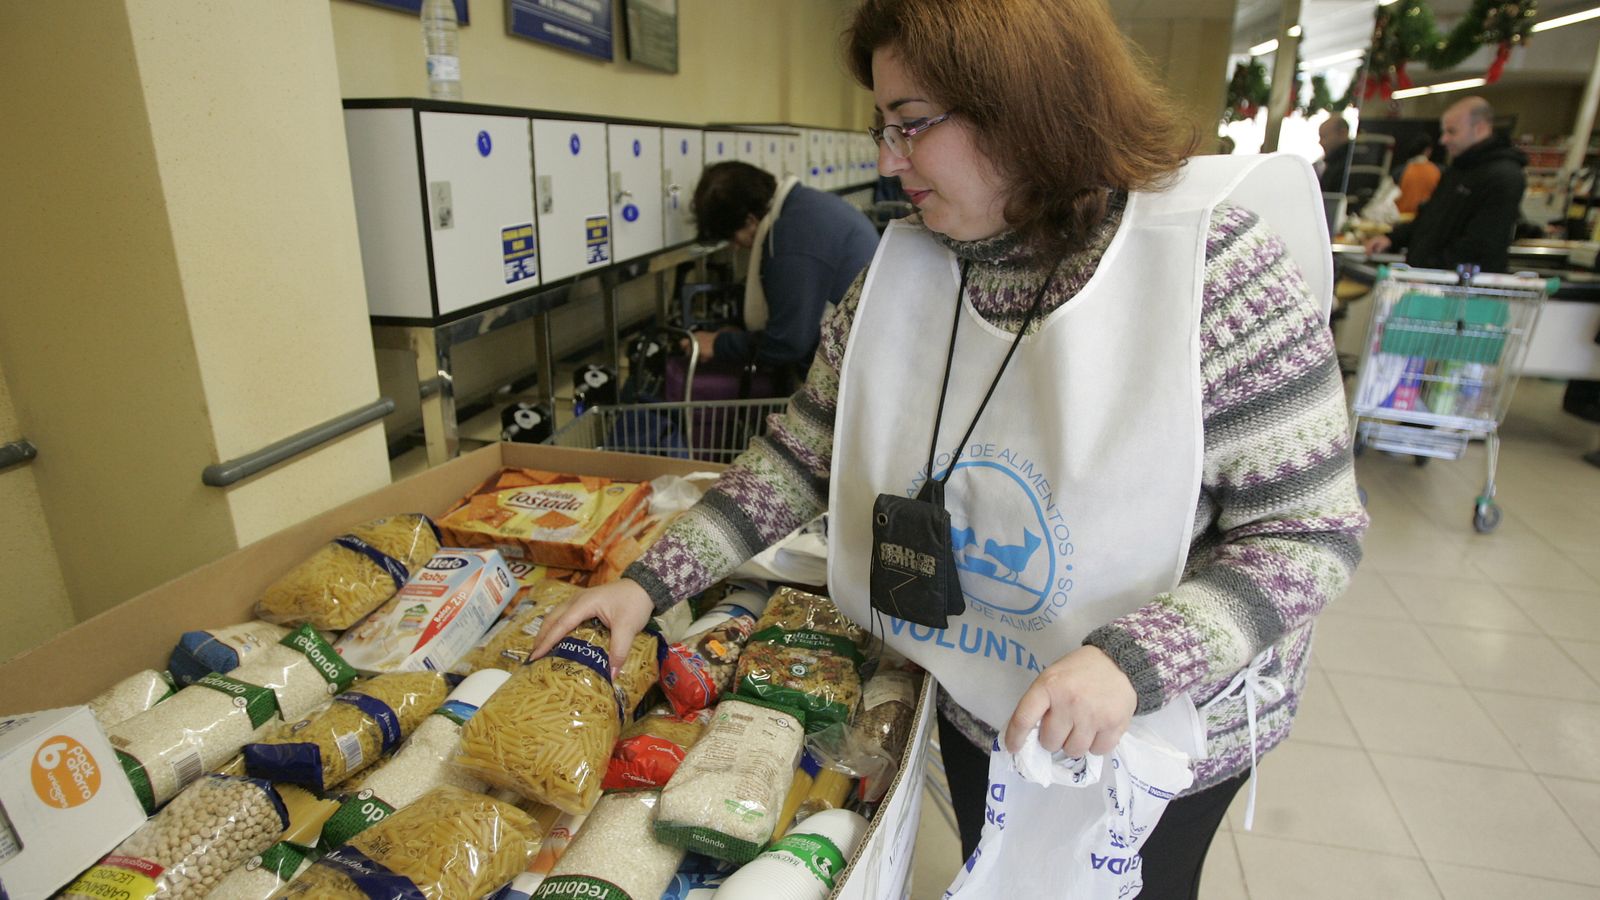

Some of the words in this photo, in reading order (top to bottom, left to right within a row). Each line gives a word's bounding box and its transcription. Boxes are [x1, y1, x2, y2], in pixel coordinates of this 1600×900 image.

[507, 491, 586, 513] Tostada
[906, 448, 964, 498] ANCOS
[969, 443, 996, 458] DE
[999, 447, 1075, 557] ALIMENTOS
[427, 557, 464, 570] Hero
[1000, 576, 1074, 633] ALIMENTOS
[293, 635, 340, 680] redondo
[559, 641, 609, 669] MACARR
[889, 616, 1048, 674] VOLUNTA
[38, 743, 68, 770] 6
[67, 746, 95, 778] pack
[66, 757, 92, 800] ahorro
[692, 832, 726, 850] redondo
[72, 880, 131, 900] GARBANZ
[537, 880, 610, 900] redondo
